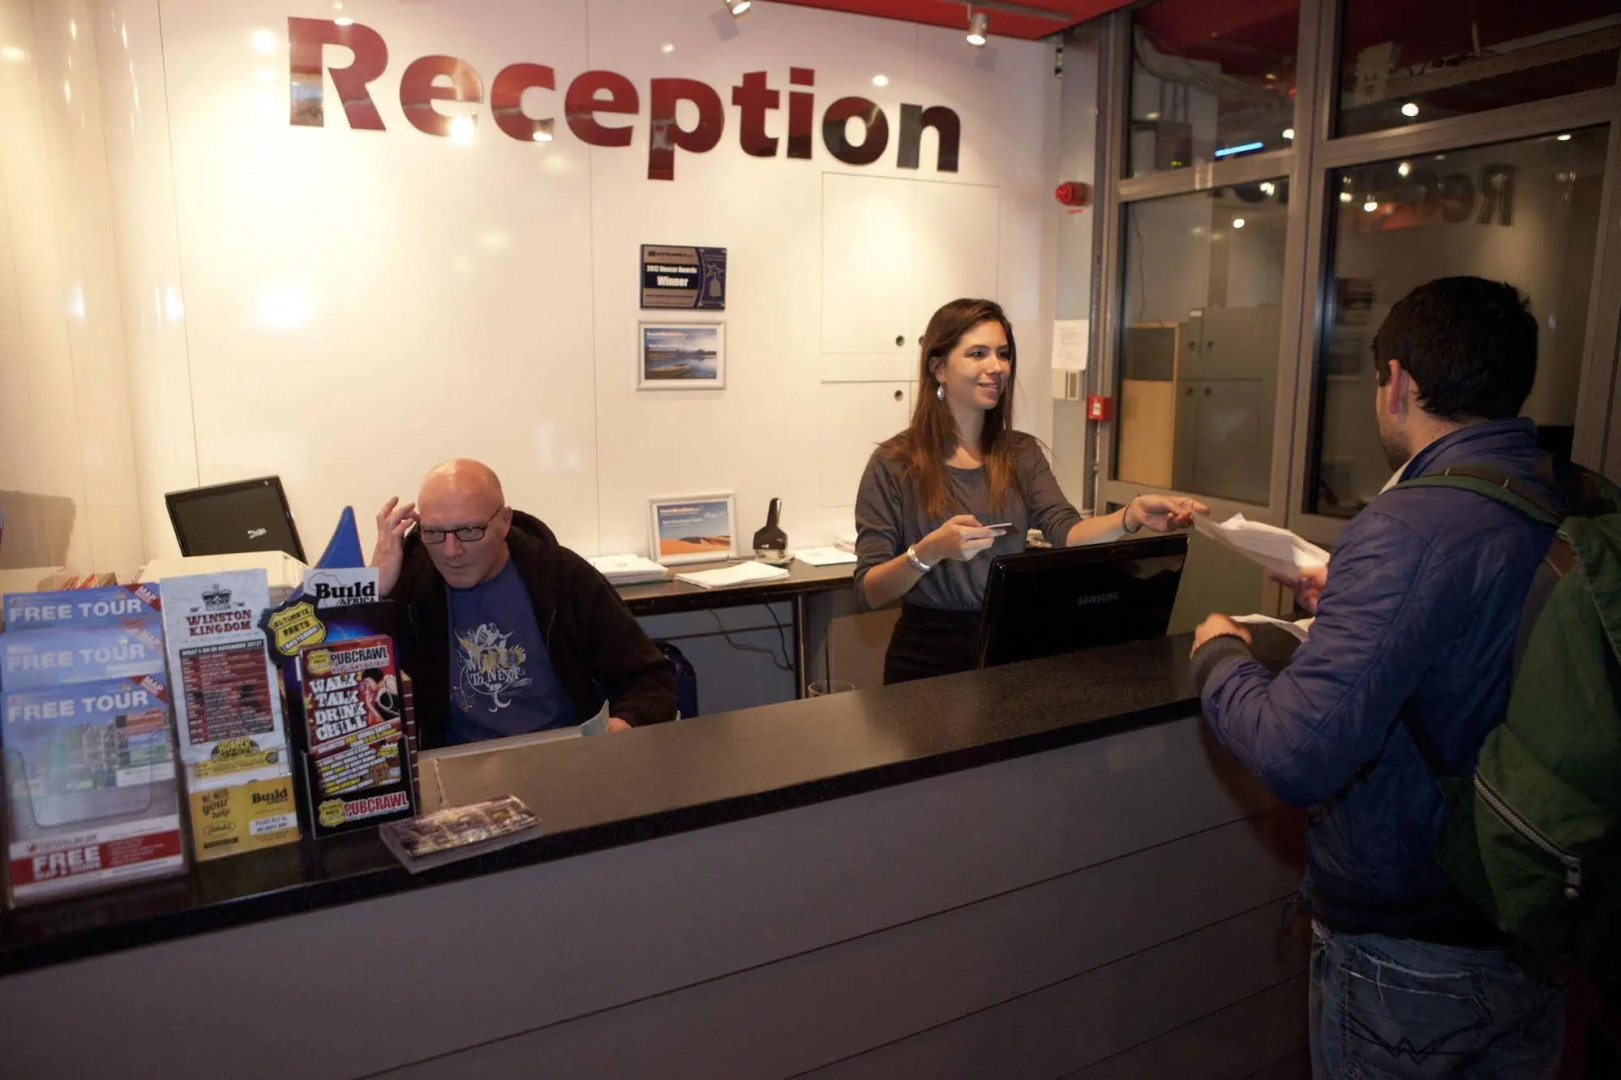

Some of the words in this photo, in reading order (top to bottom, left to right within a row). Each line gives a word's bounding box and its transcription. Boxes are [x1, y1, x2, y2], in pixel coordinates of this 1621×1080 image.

[288, 17, 962, 181] Reception
[657, 275, 689, 287] Winner
[315, 581, 376, 600] Build
[338, 596, 376, 605] AFRICA
[10, 604, 73, 622] FREE
[79, 599, 142, 617] TOUR
[186, 609, 252, 626] WINSTON
[189, 620, 252, 636] KINGDOM
[7, 651, 74, 672] FREE
[79, 644, 146, 663] TOUR
[330, 646, 388, 665] PUBCRAWL
[309, 673, 358, 694] WALK
[8, 700, 75, 722] FREE
[81, 690, 149, 713] TOUR
[315, 690, 359, 707] TALK
[315, 702, 367, 725] DRINK
[316, 715, 367, 740] CHILL
[252, 788, 288, 804] Build
[344, 792, 408, 815] PUBCRAWL
[202, 799, 230, 816] your
[33, 846, 101, 870] FREE
